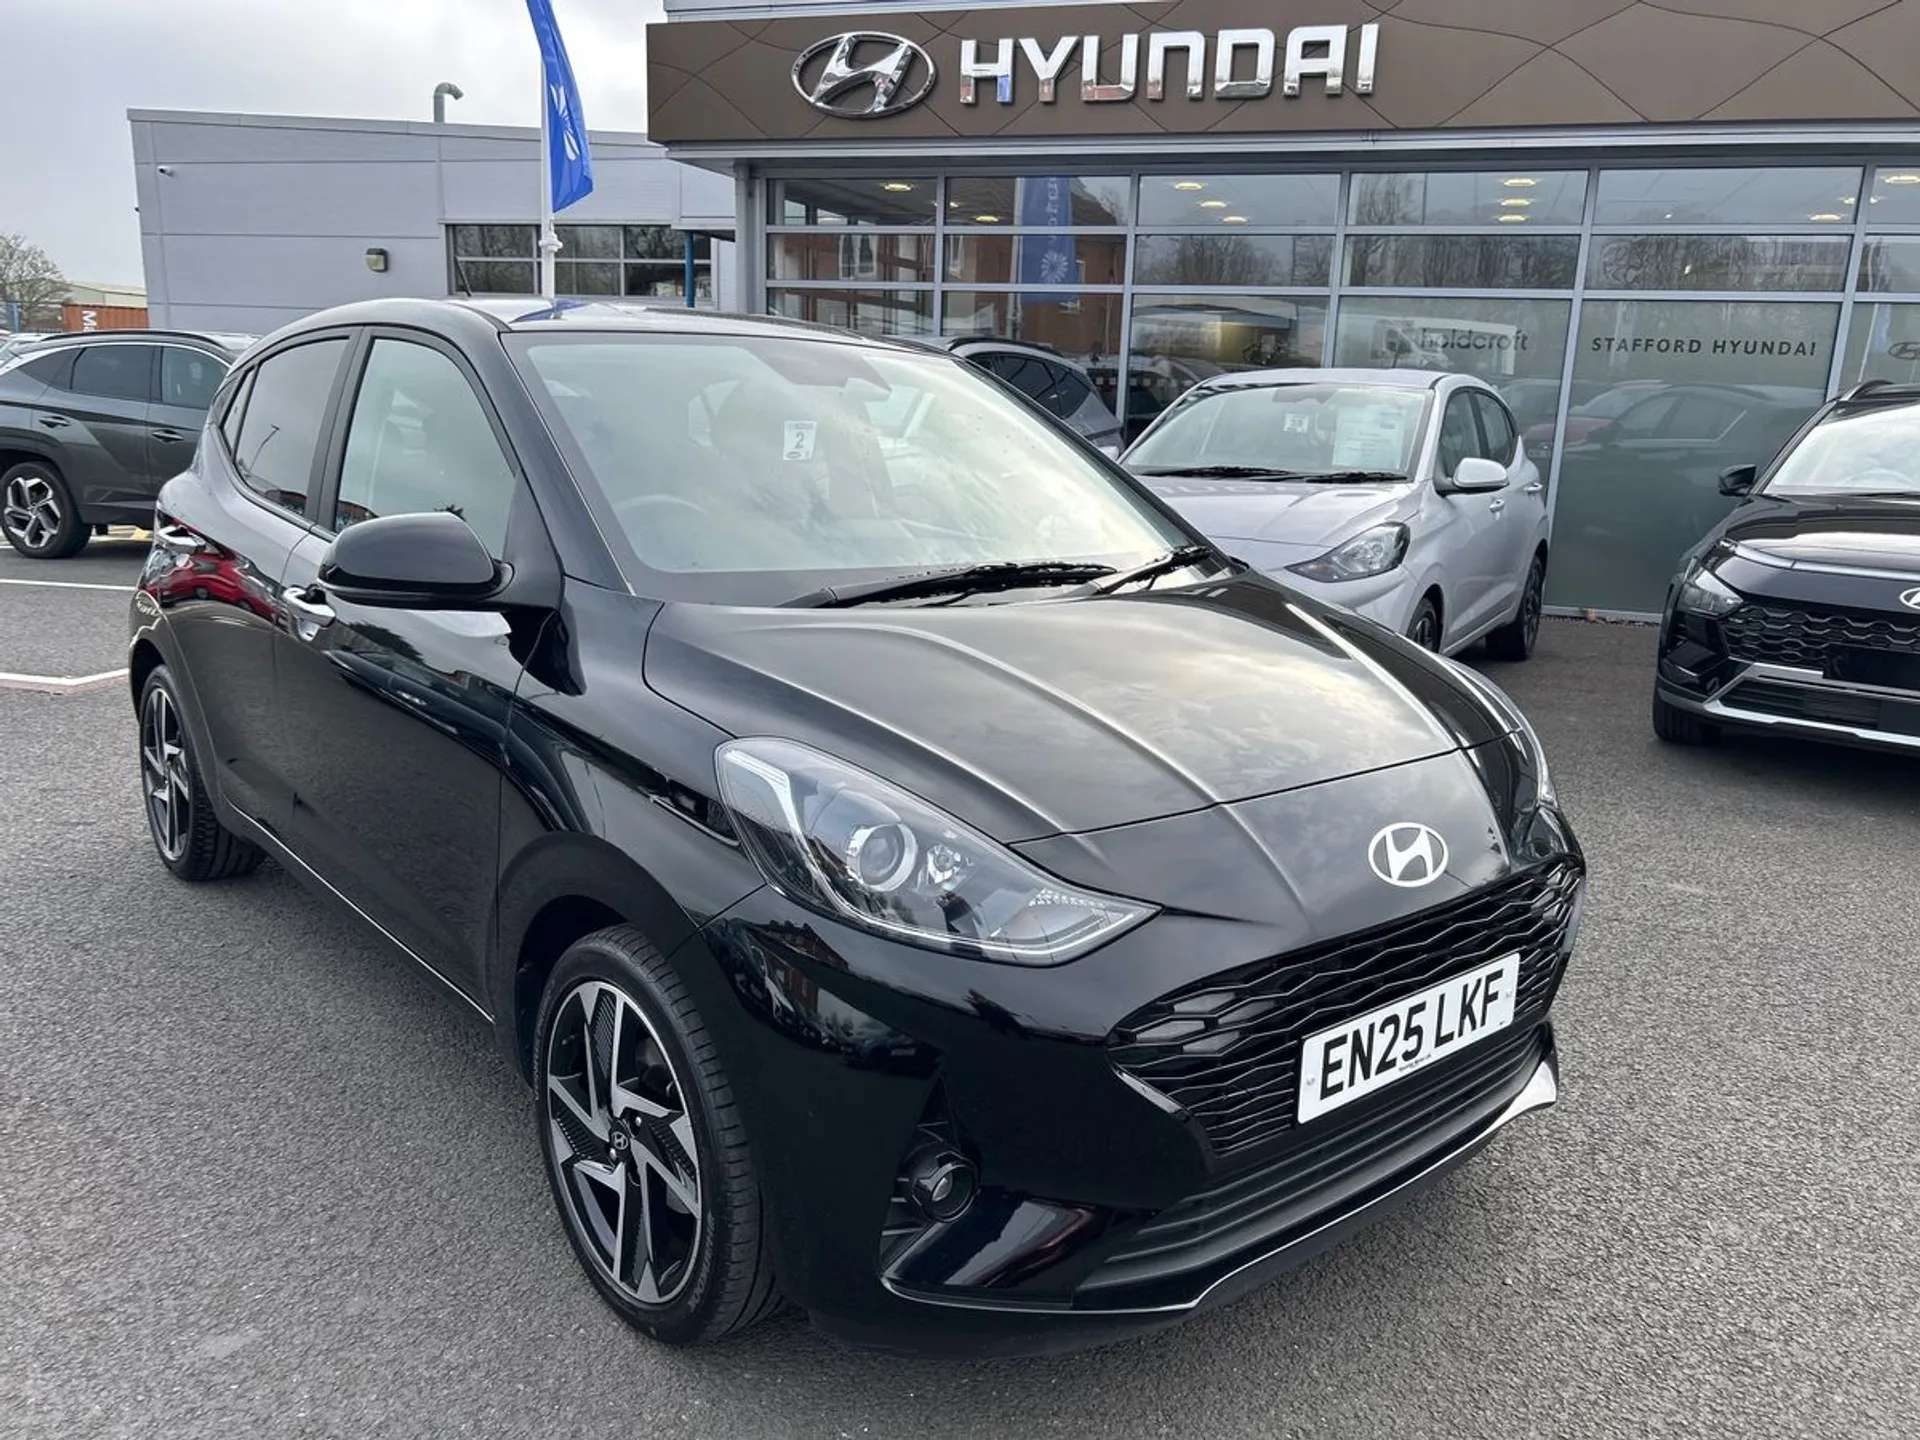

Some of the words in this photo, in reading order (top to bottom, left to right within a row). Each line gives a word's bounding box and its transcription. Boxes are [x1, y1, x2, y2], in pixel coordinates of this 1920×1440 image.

[959, 24, 1379, 104] HYUNDAI
[1592, 337, 1702, 353] STAFFORD
[1712, 339, 1816, 356] HYUNDAI
[795, 431, 804, 449] 2
[1320, 1001, 1427, 1100] EN25
[1434, 969, 1504, 1049] LKF
